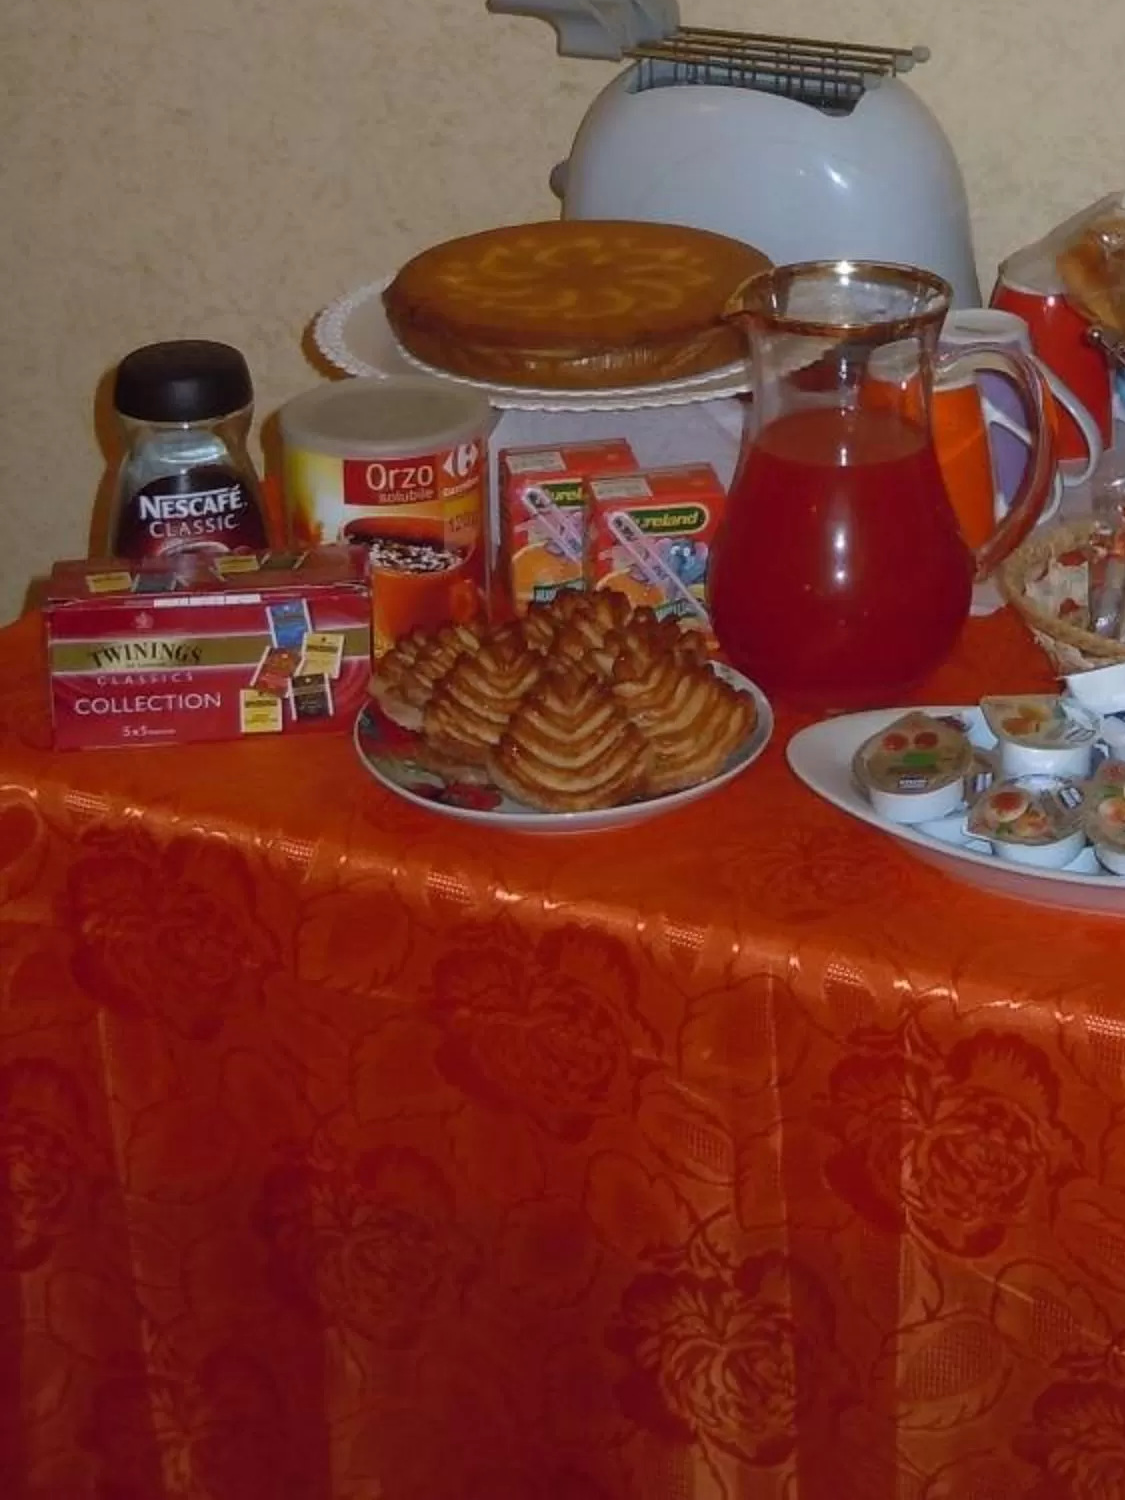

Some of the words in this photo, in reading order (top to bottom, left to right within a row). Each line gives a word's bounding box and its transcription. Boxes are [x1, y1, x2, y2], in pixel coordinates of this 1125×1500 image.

[366, 463, 433, 490] Orzo
[139, 484, 241, 520] NESCAFÉ
[149, 514, 239, 538] CLASSIC
[88, 641, 202, 668] TWININGS
[97, 671, 193, 685] CLASSICS
[75, 692, 221, 715] COLLECTION
